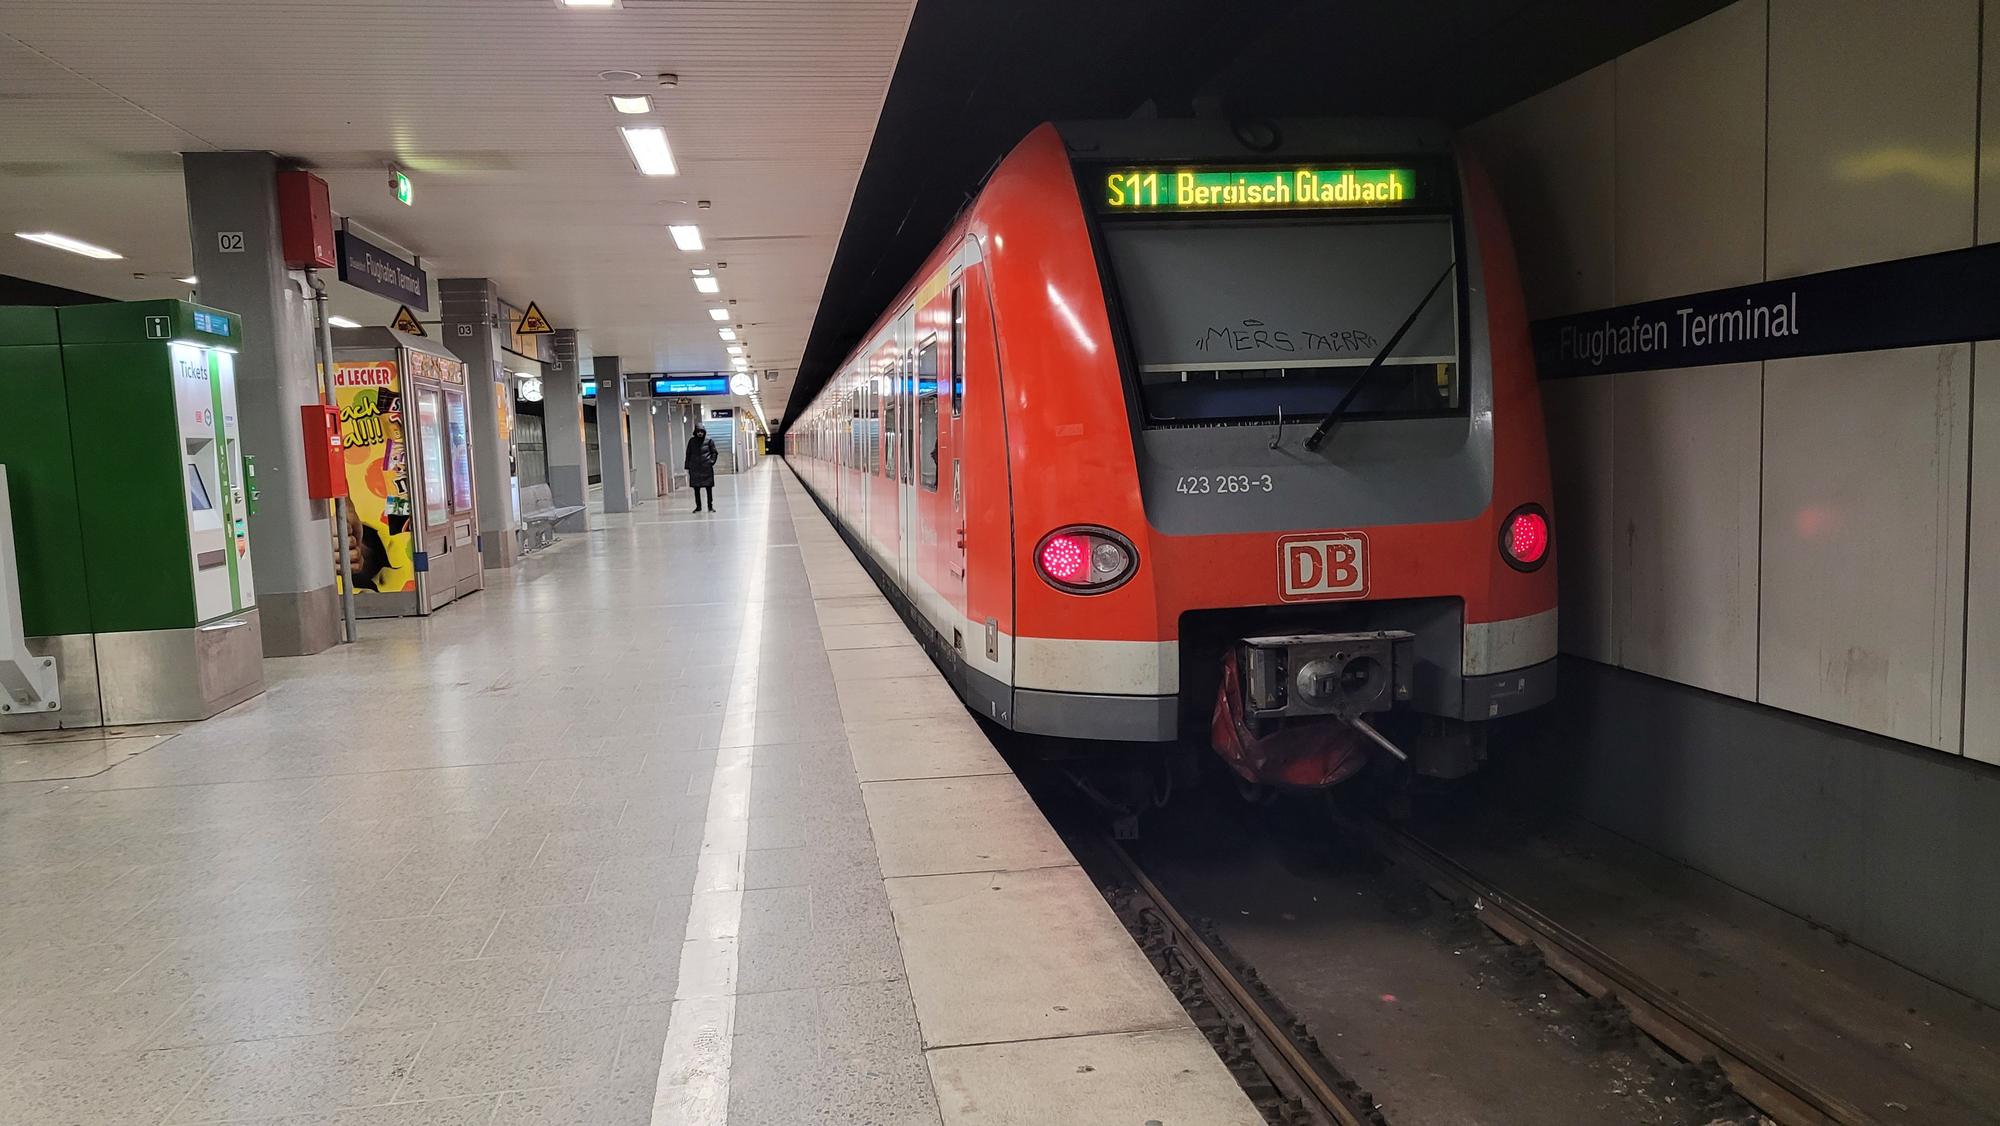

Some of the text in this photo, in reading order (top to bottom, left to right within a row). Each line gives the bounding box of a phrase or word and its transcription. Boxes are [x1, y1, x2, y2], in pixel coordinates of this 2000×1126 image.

[1107, 171, 1403, 206] S11 Bergisch Gladbach
[220, 235, 242, 249] 02
[365, 252, 397, 284] Flughafen
[397, 266, 420, 296] Terminal
[458, 325, 471, 334] 03
[1560, 291, 1799, 366] Flughafen Terminal
[179, 361, 207, 381] Tickets
[347, 368, 390, 386] LECKER
[340, 396, 380, 422] ach
[343, 417, 384, 449] al!!!
[1176, 475, 1273, 494] 423 263-3
[1290, 544, 1359, 590] DB
